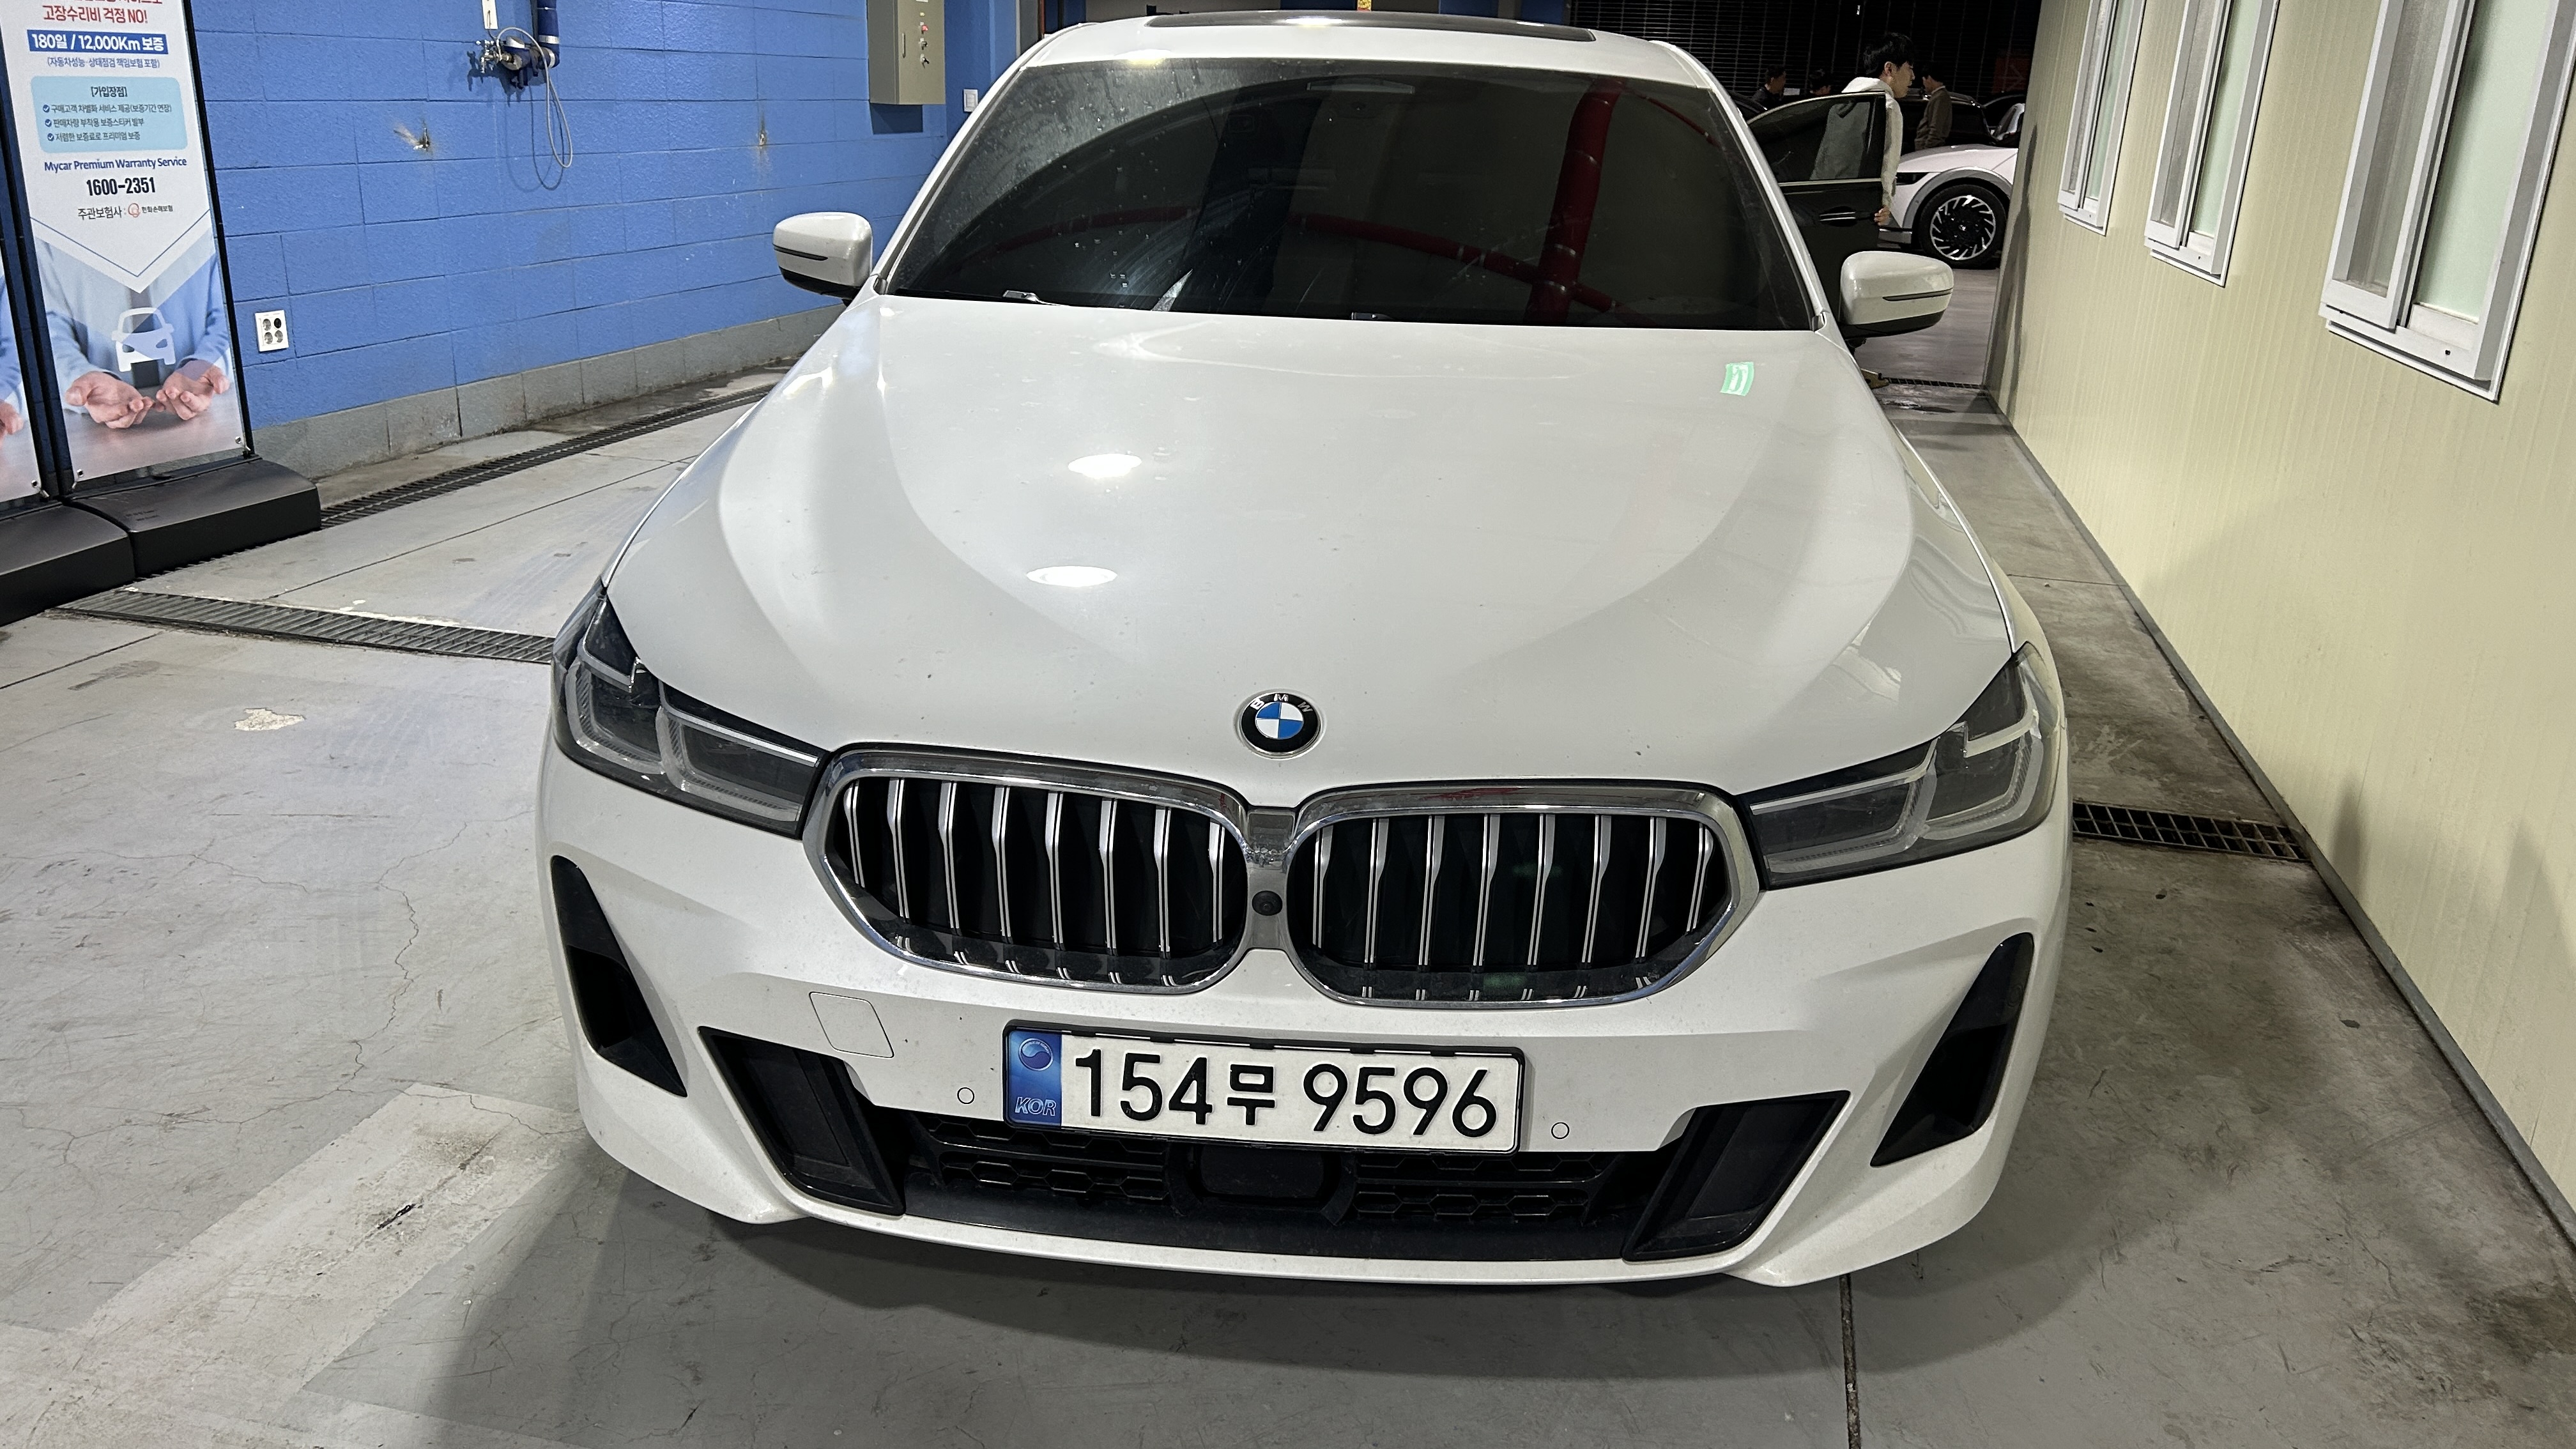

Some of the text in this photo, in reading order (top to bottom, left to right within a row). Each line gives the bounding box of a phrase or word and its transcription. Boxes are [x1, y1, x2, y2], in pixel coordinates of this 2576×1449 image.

[42, 5, 148, 24] 고장수리비 걱정 NO!
[32, 34, 68, 49] 180일
[79, 35, 141, 51] 12,000Km
[142, 37, 164, 52] 보증
[116, 58, 143, 68] 책임보험
[144, 59, 160, 69] 포함)
[91, 86, 128, 97] [가입장점]
[51, 104, 77, 114] 구매고객
[98, 104, 117, 113] 서비스
[157, 104, 172, 113] 연장)
[53, 118, 79, 128] 판매차량
[80, 118, 100, 128] 부착용
[100, 118, 132, 127] 보증스티커
[55, 132, 141, 142] 저렴한 보증료로 프리미엄 보증
[44, 156, 187, 173] Mycar Premium Warranty Service
[86, 176, 156, 196] 1600-2351
[77, 206, 122, 220] 주관보험사
[1250, 693, 1314, 712] BMW
[1075, 1048, 1498, 1138] 154무 9596
[1015, 1096, 1057, 1117] KOR
